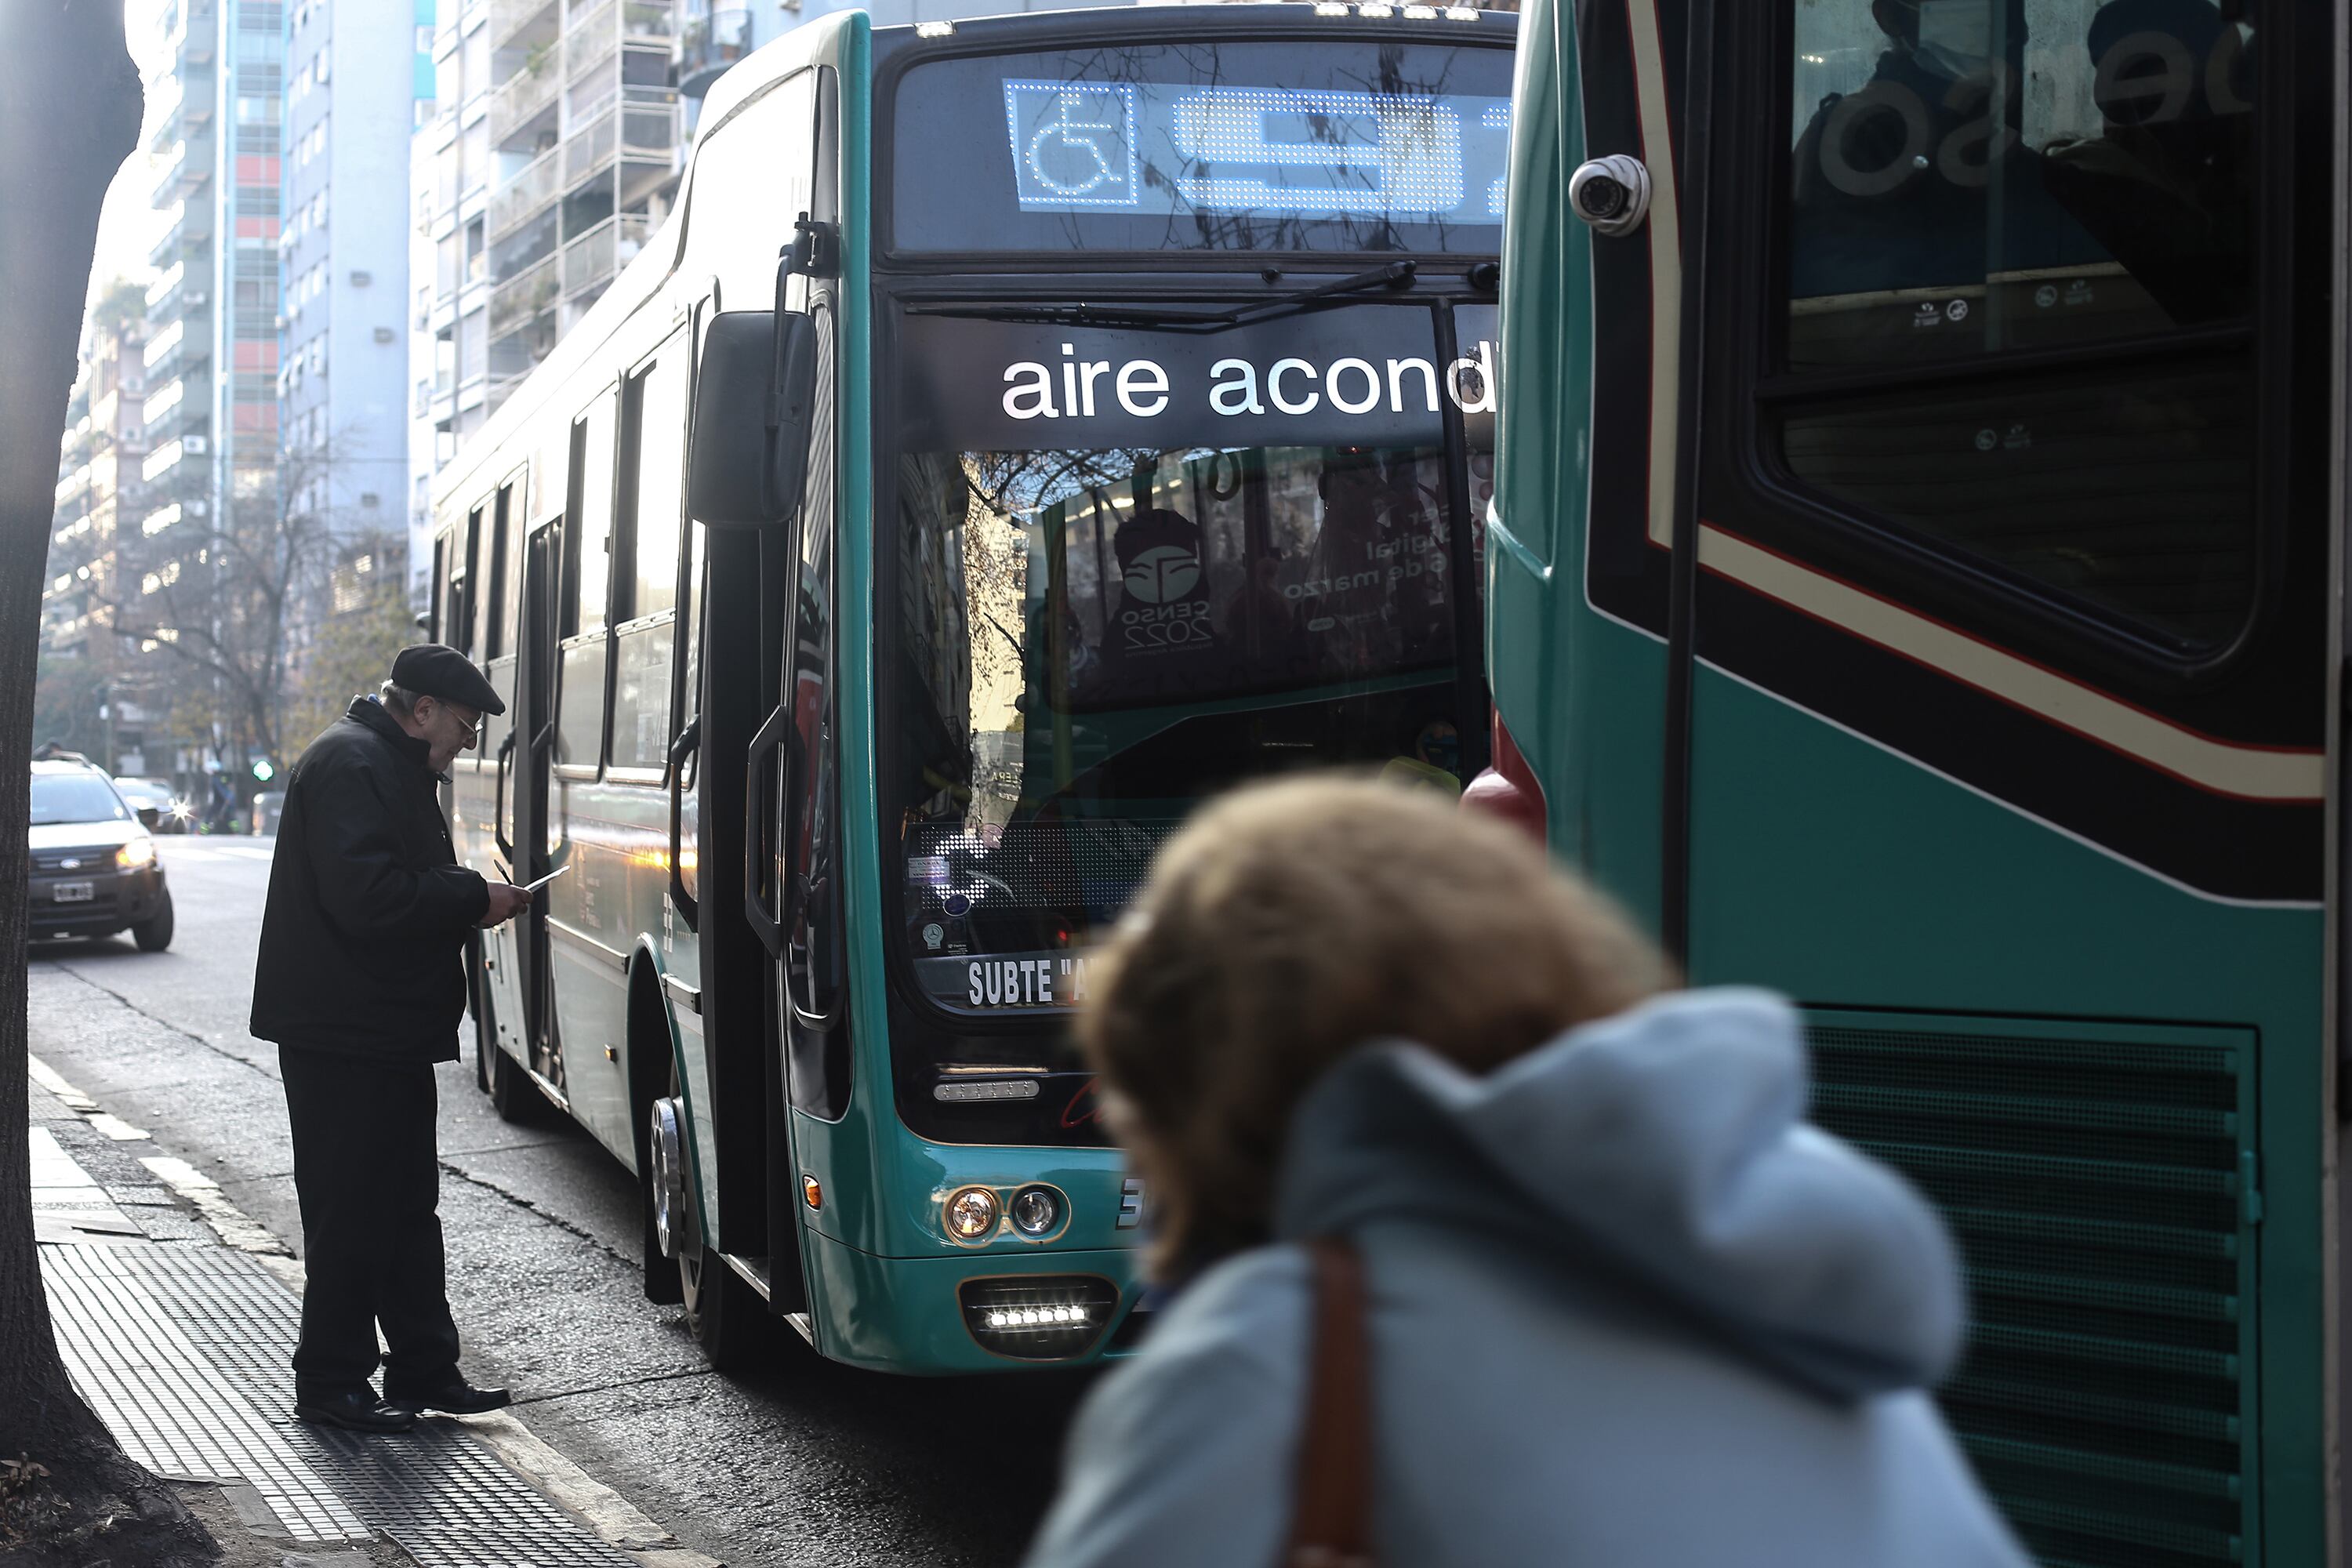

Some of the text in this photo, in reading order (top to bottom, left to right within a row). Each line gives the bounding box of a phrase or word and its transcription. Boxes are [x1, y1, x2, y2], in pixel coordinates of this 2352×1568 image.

[1001, 340, 1499, 419] aire acond
[968, 959, 1053, 1006] SUBTE
[1116, 1179, 1147, 1230] 3
